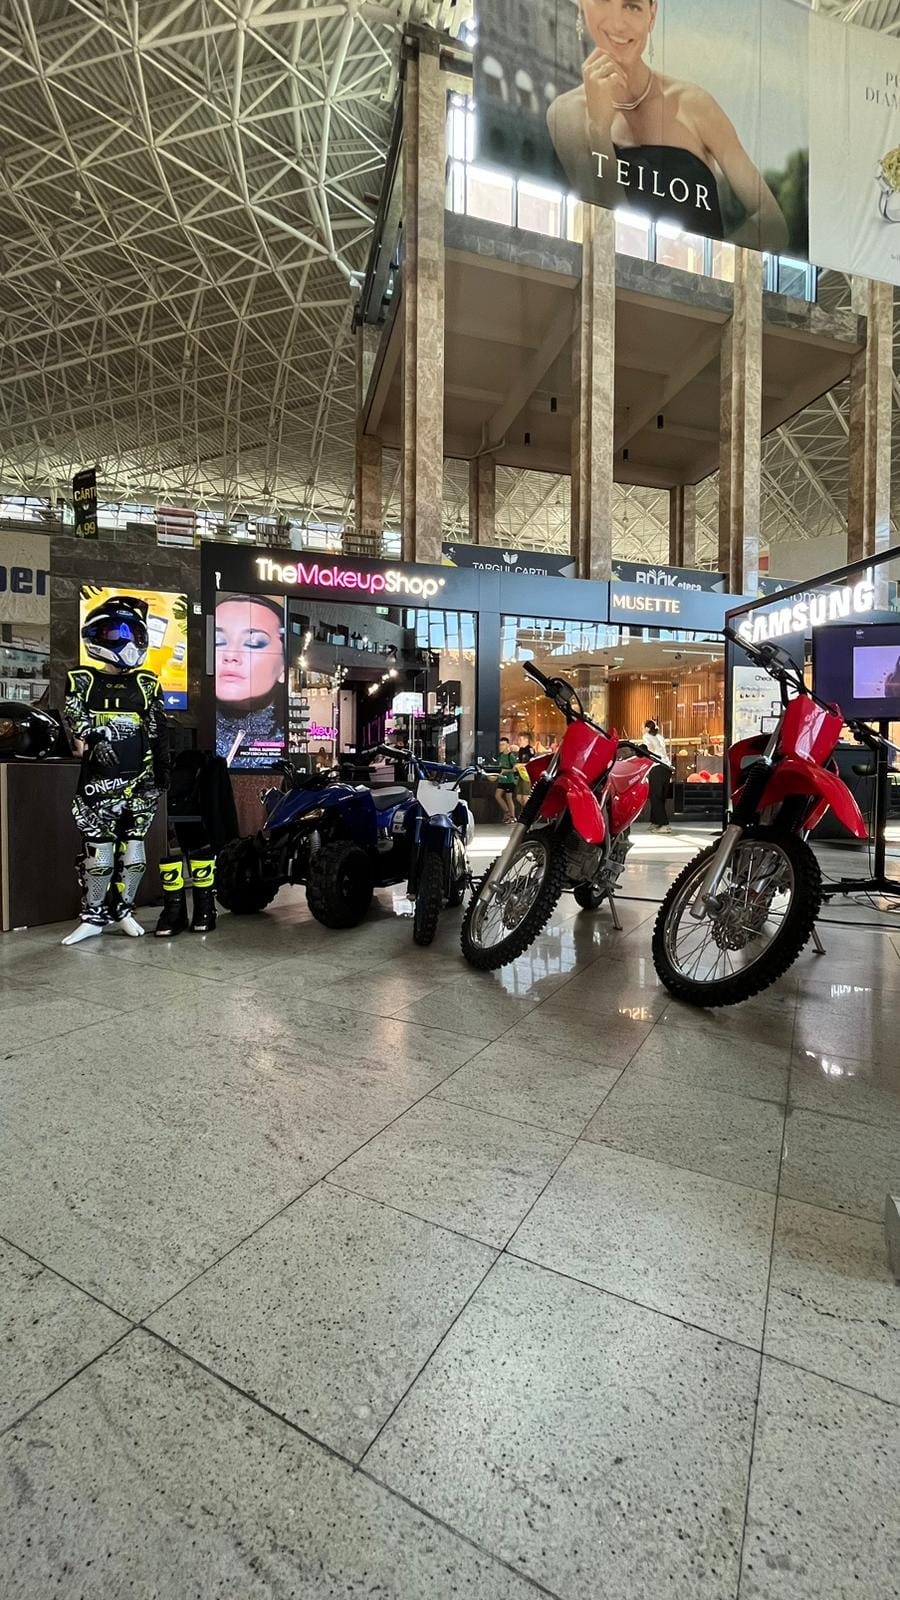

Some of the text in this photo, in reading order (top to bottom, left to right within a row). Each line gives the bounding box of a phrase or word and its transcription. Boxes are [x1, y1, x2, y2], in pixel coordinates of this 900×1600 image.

[591, 151, 711, 211] TEILOR
[76, 521, 96, 538] 4,99
[256, 557, 441, 599] TheMakeupShop
[613, 594, 681, 614] MUSETTE
[738, 580, 875, 643] SAMSUNG
